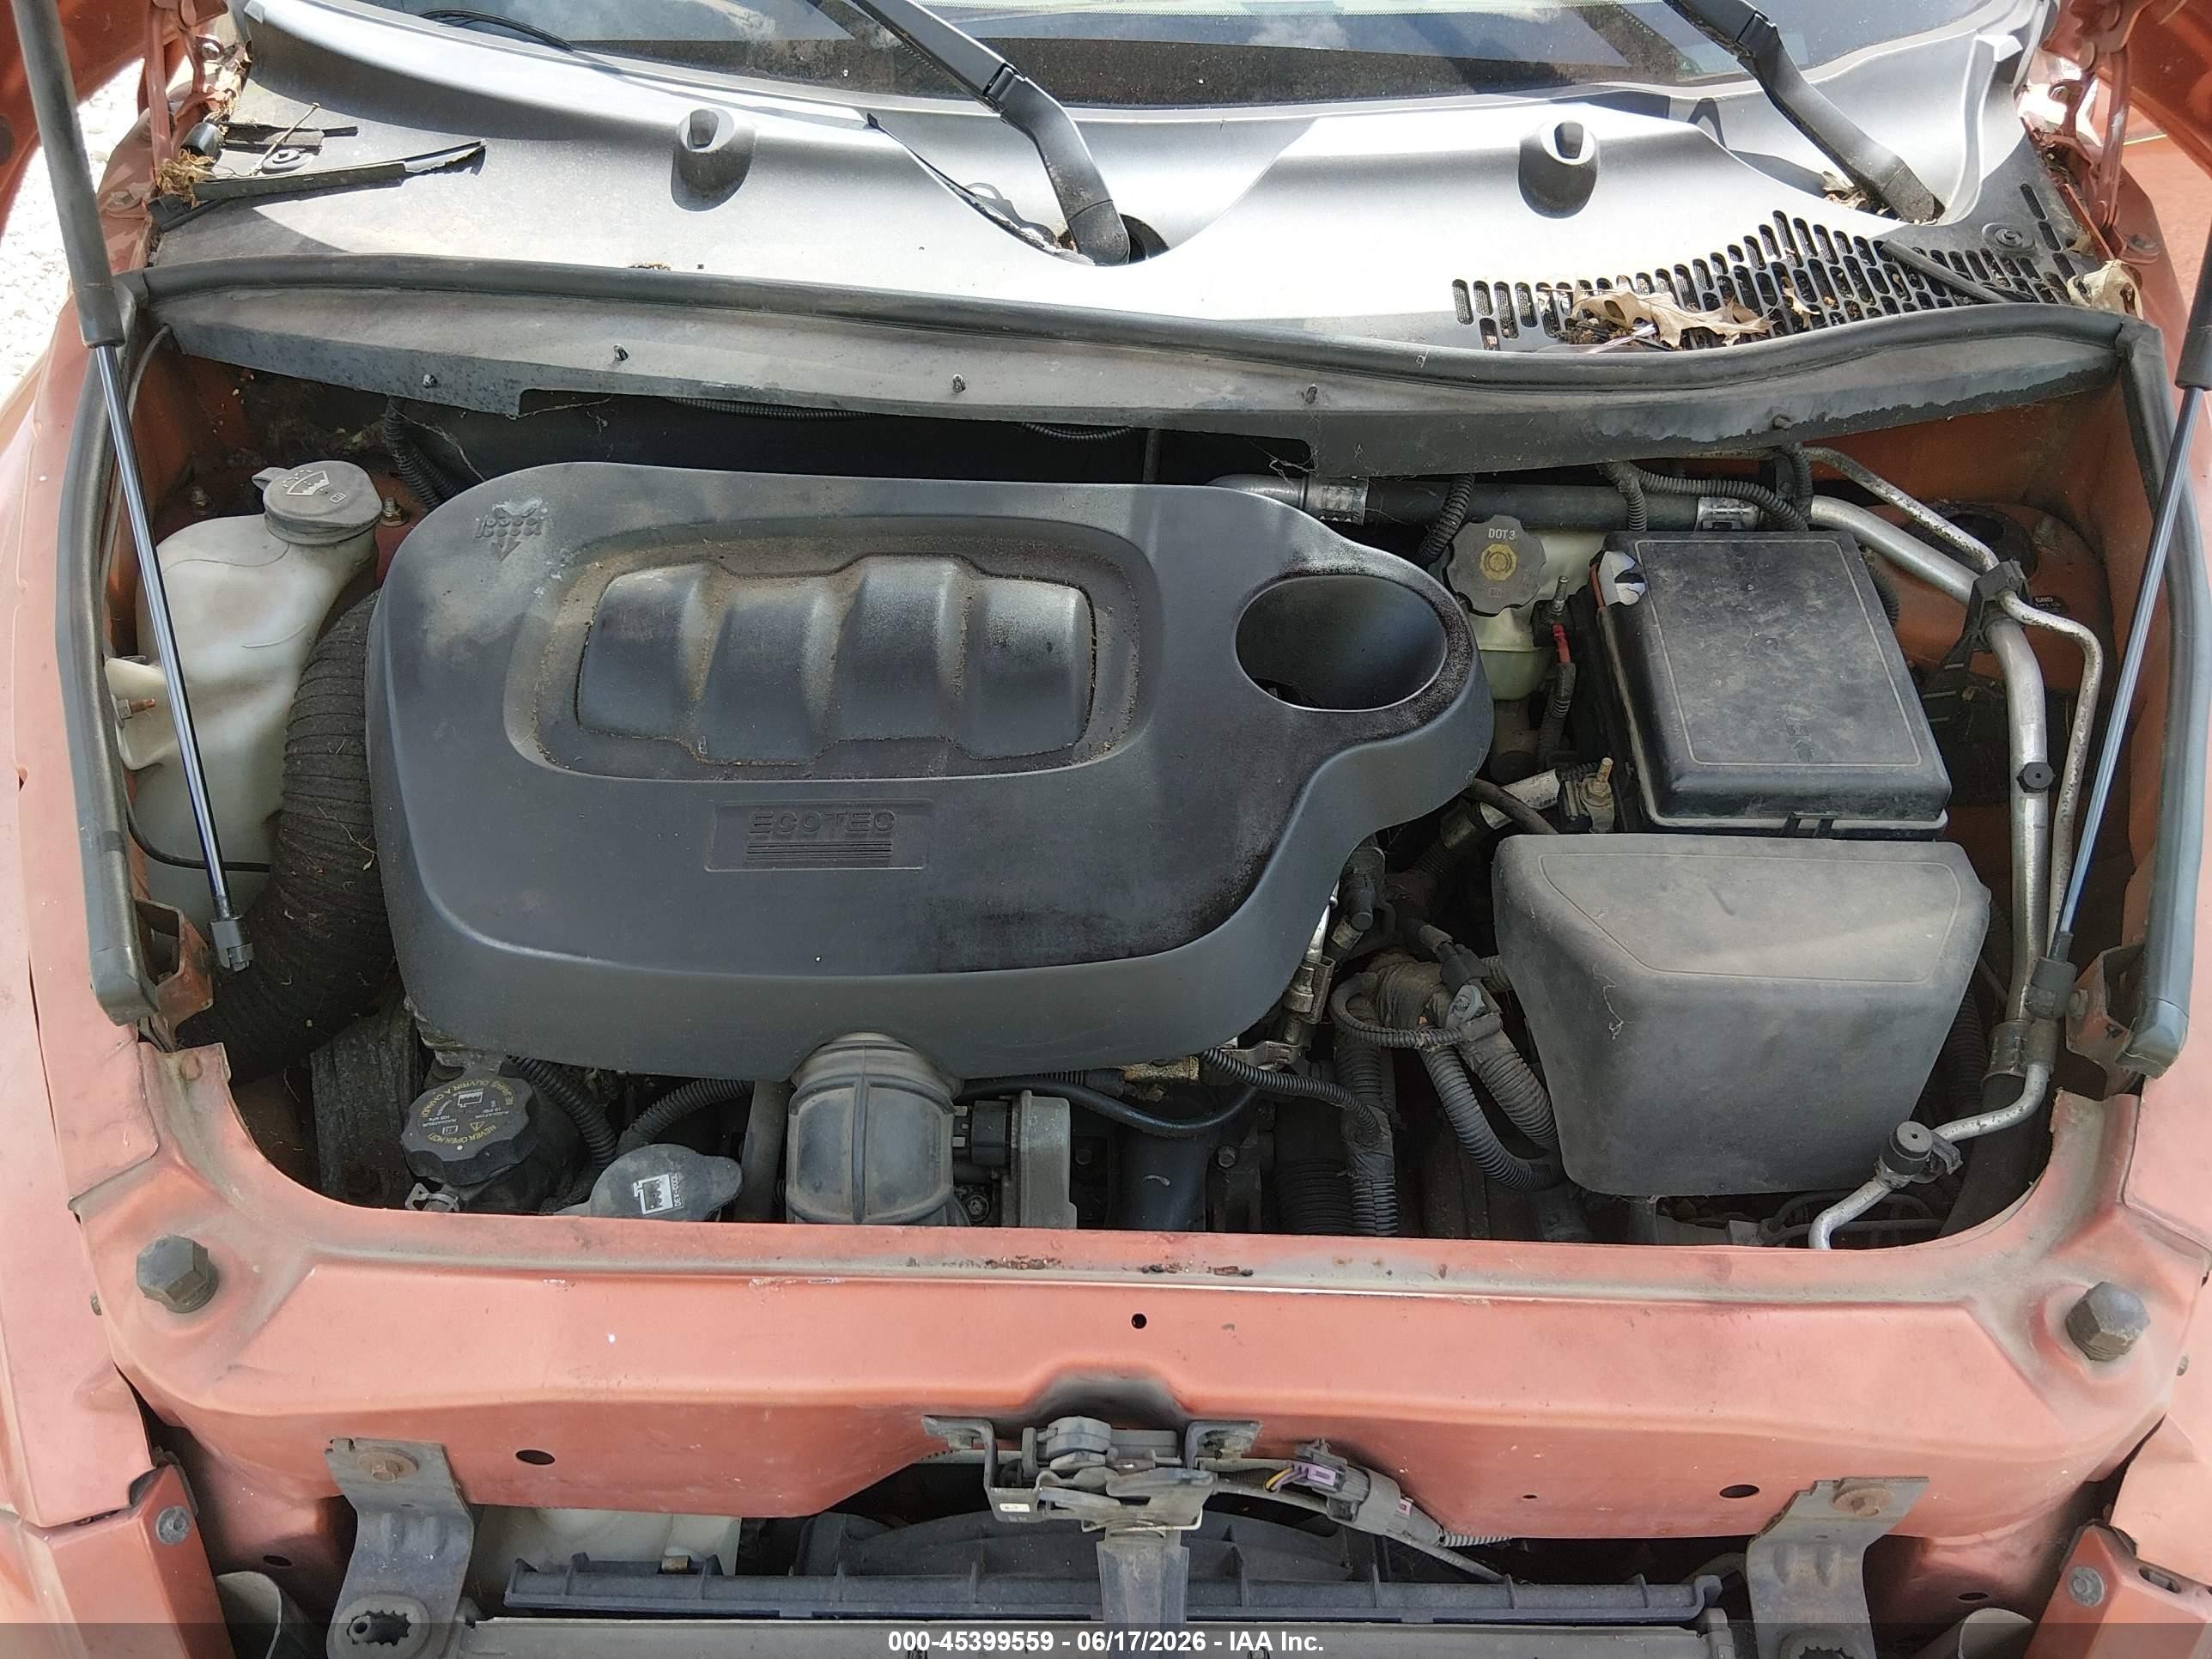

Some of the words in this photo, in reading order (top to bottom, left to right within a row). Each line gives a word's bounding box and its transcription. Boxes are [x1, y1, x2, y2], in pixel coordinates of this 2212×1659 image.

[1488, 528, 1509, 540] DOT
[1509, 530, 1516, 541] 3
[749, 810, 895, 834] ECOTEC
[445, 1135, 468, 1144] OPEN
[672, 1173, 682, 1207] DEX-COOL
